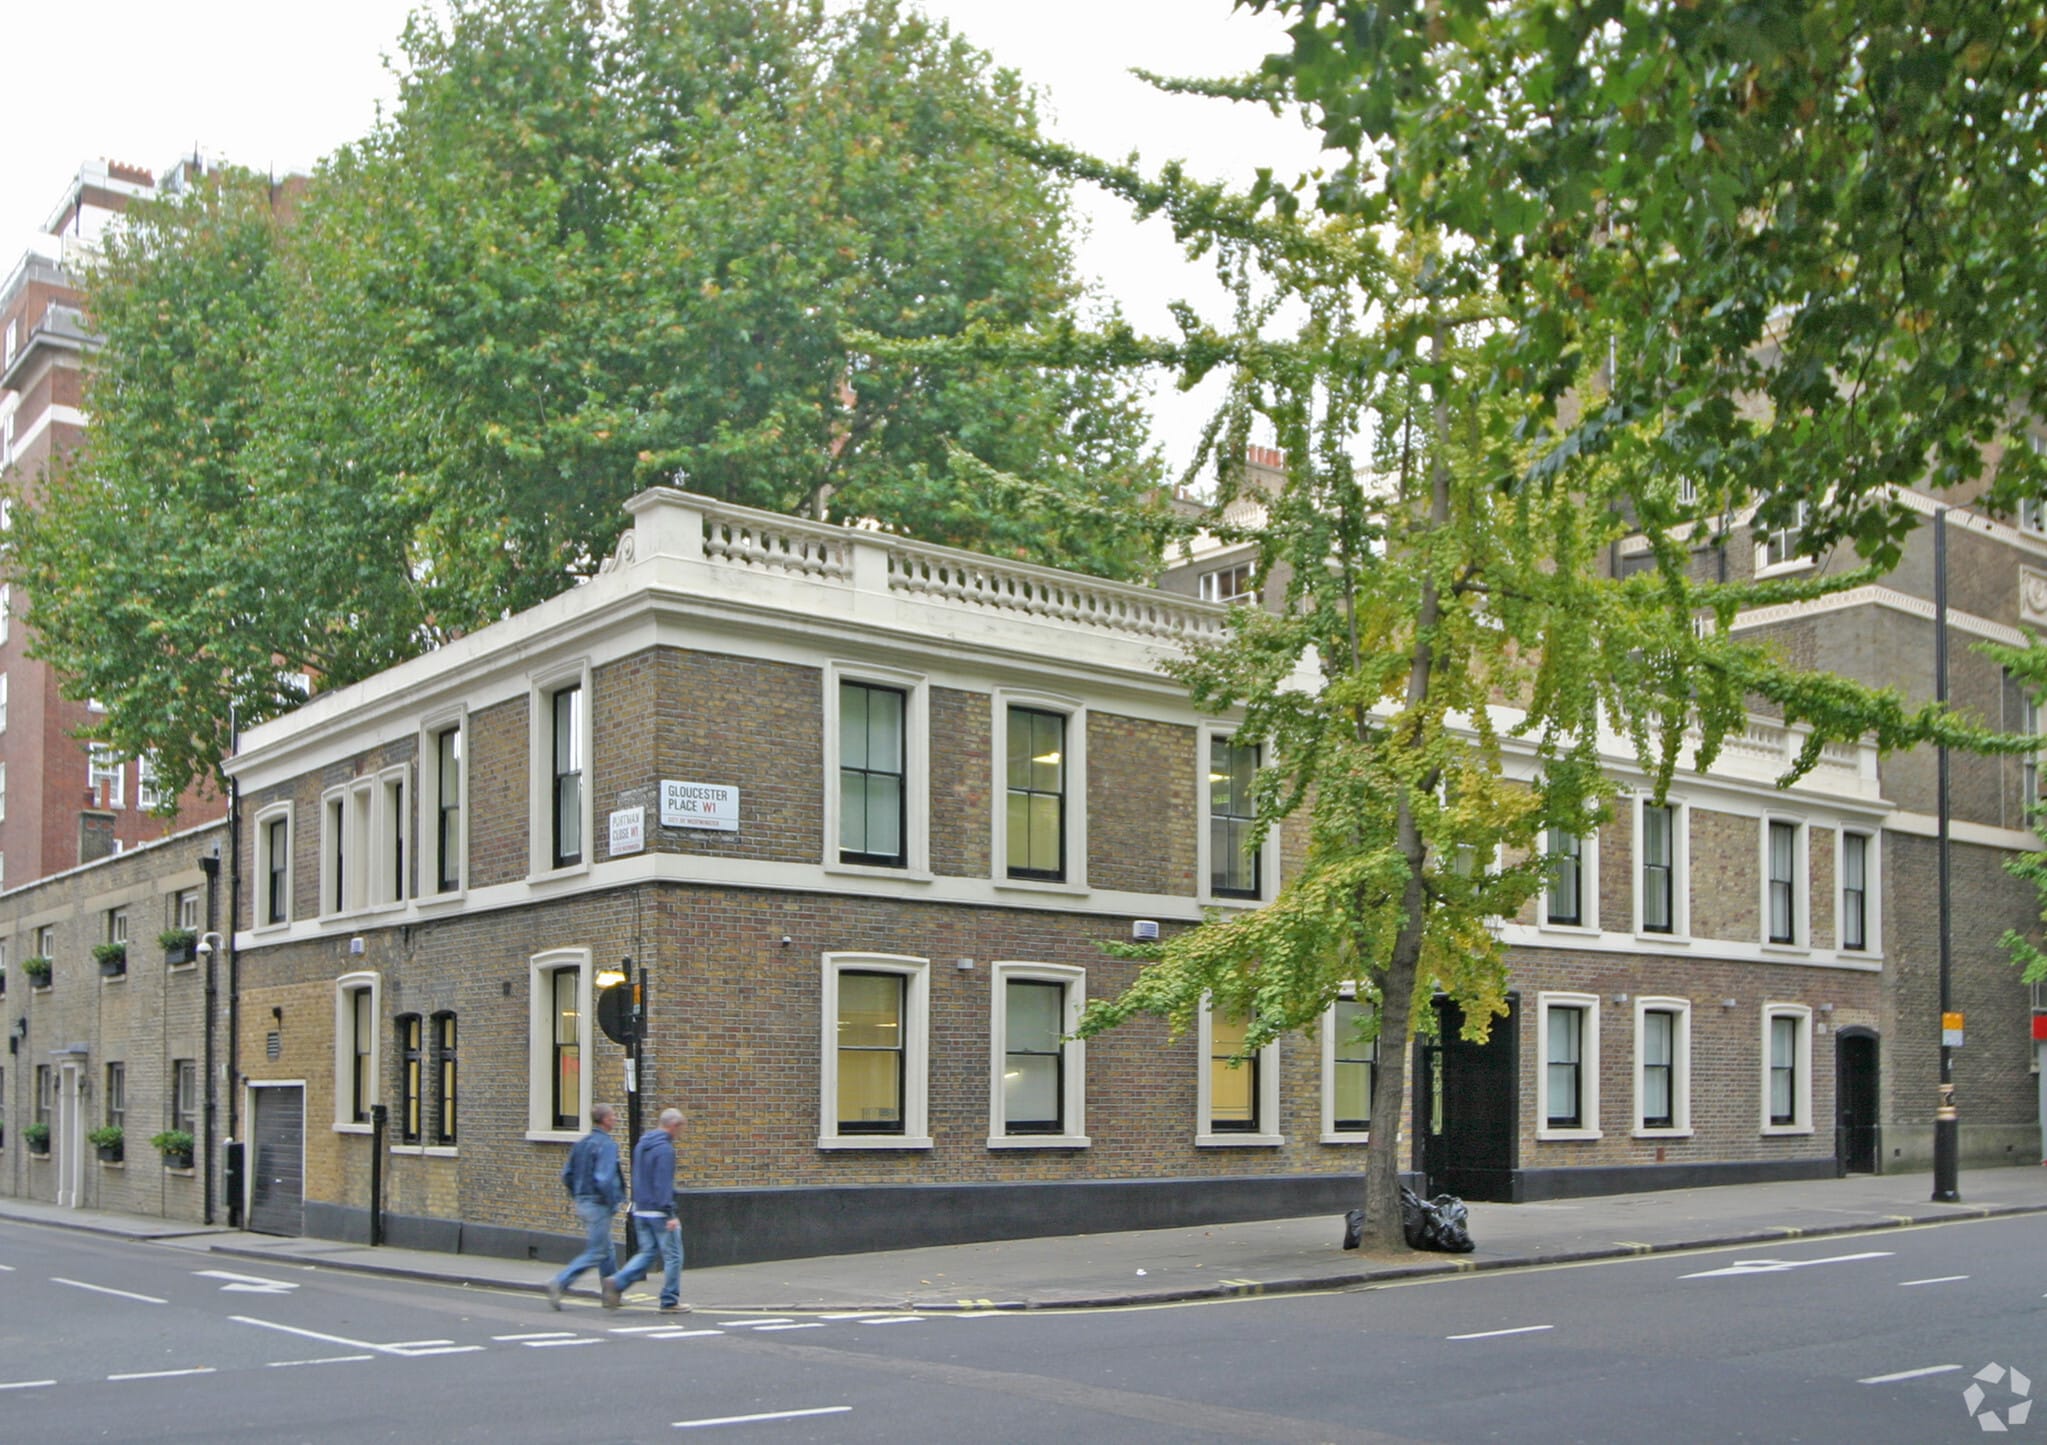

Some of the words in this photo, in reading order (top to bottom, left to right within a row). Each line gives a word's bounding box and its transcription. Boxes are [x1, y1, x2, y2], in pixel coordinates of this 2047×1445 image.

[668, 785, 728, 801] GLOUCESTER
[668, 798, 698, 812] PLACE
[703, 801, 716, 813] W1
